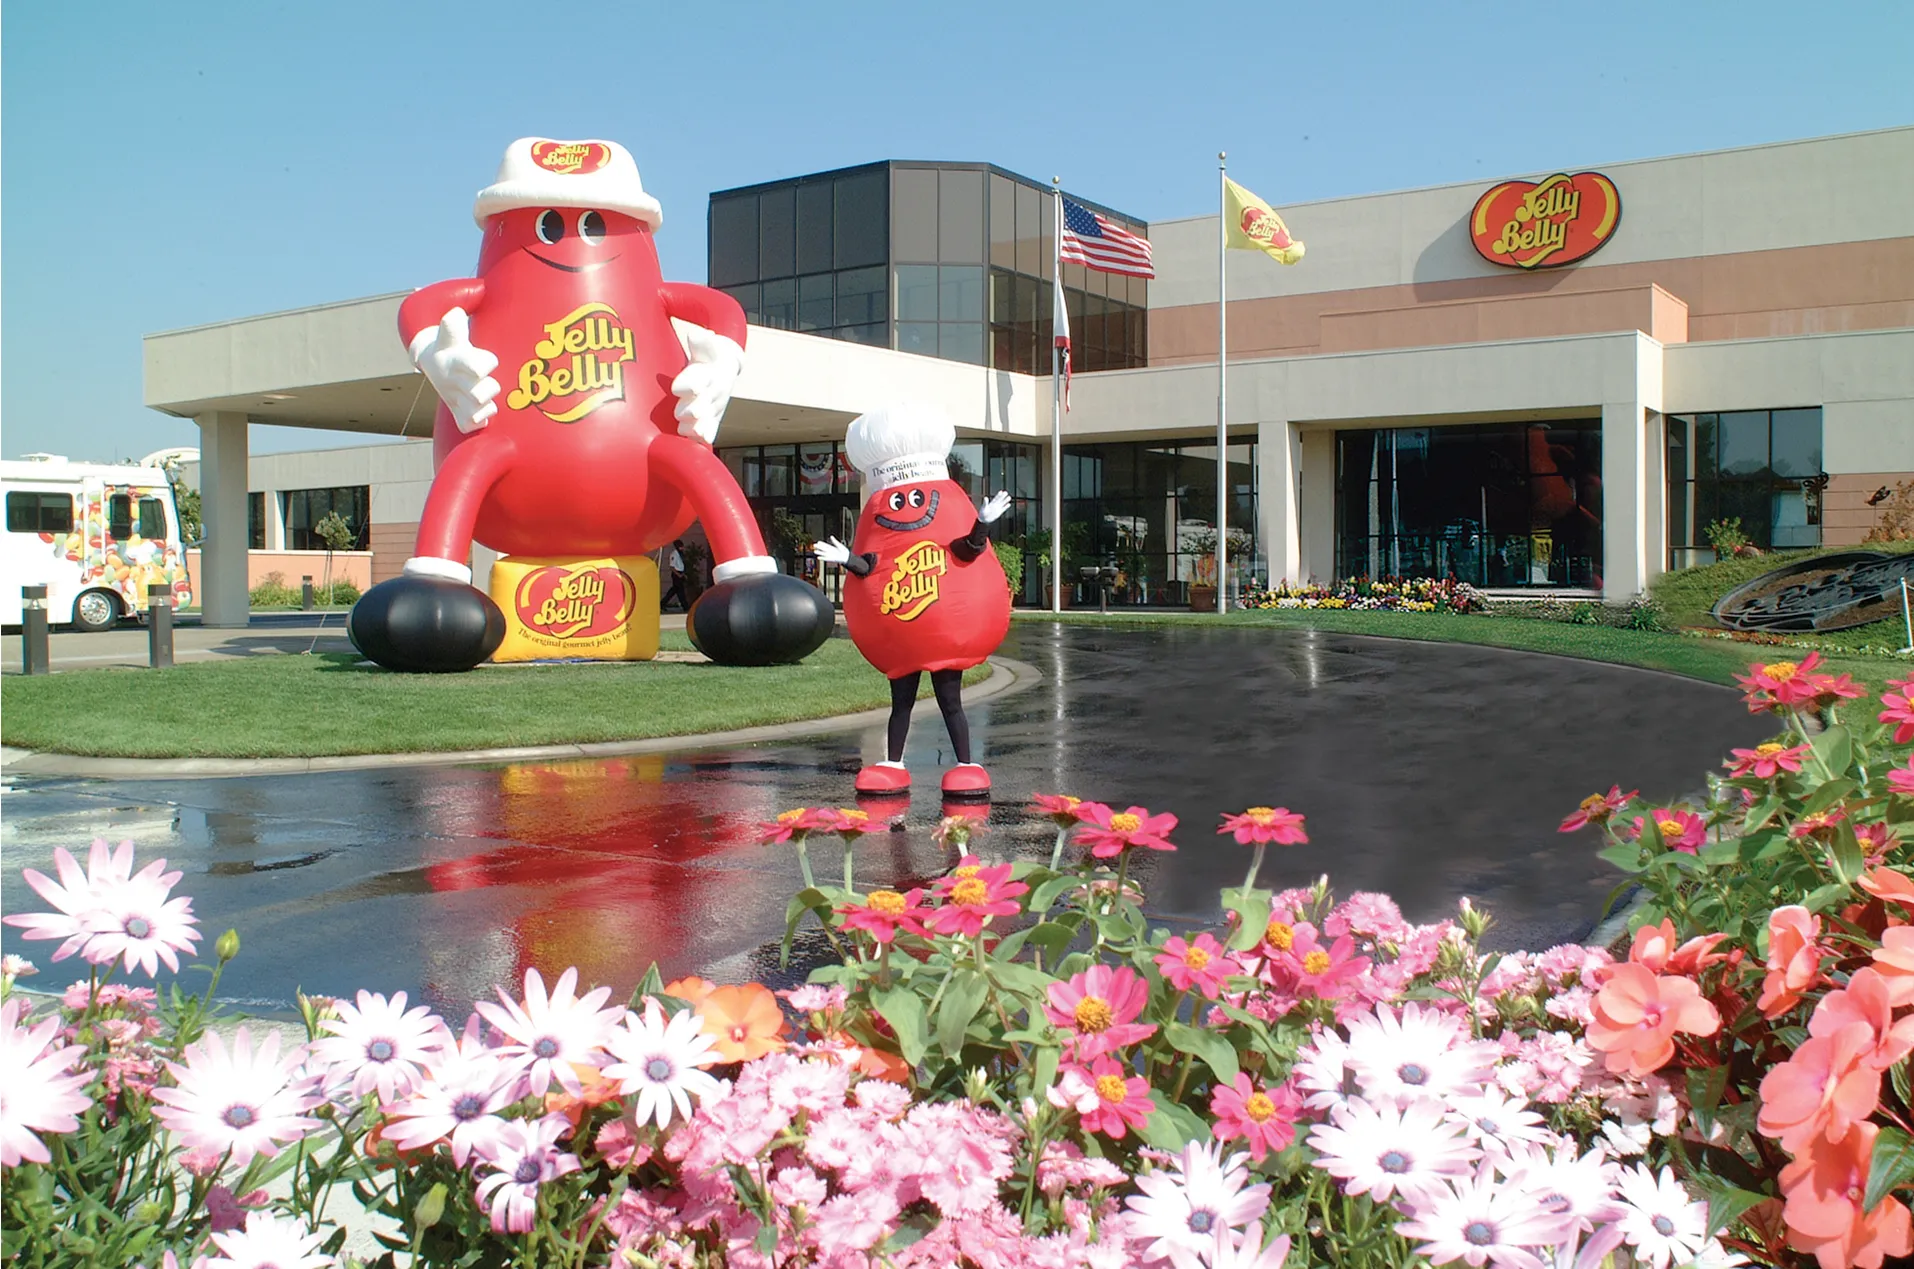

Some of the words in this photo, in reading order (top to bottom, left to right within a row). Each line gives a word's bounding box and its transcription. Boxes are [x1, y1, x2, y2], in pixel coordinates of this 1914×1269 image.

[542, 151, 585, 174] Belly
[555, 144, 591, 158] Jelly
[1515, 173, 1582, 222] Jelly
[1248, 221, 1276, 242] Belly
[1492, 219, 1568, 269] Belly
[534, 301, 637, 362] Jelly
[506, 353, 626, 424] Belly
[891, 540, 948, 582] Jelly
[552, 565, 606, 604] Jelly
[880, 572, 939, 622] Belly
[518, 628, 531, 640] The
[531, 637, 561, 648] original
[561, 640, 596, 649] gourmet
[595, 637, 611, 648] jelly
[533, 599, 595, 639] Belly
